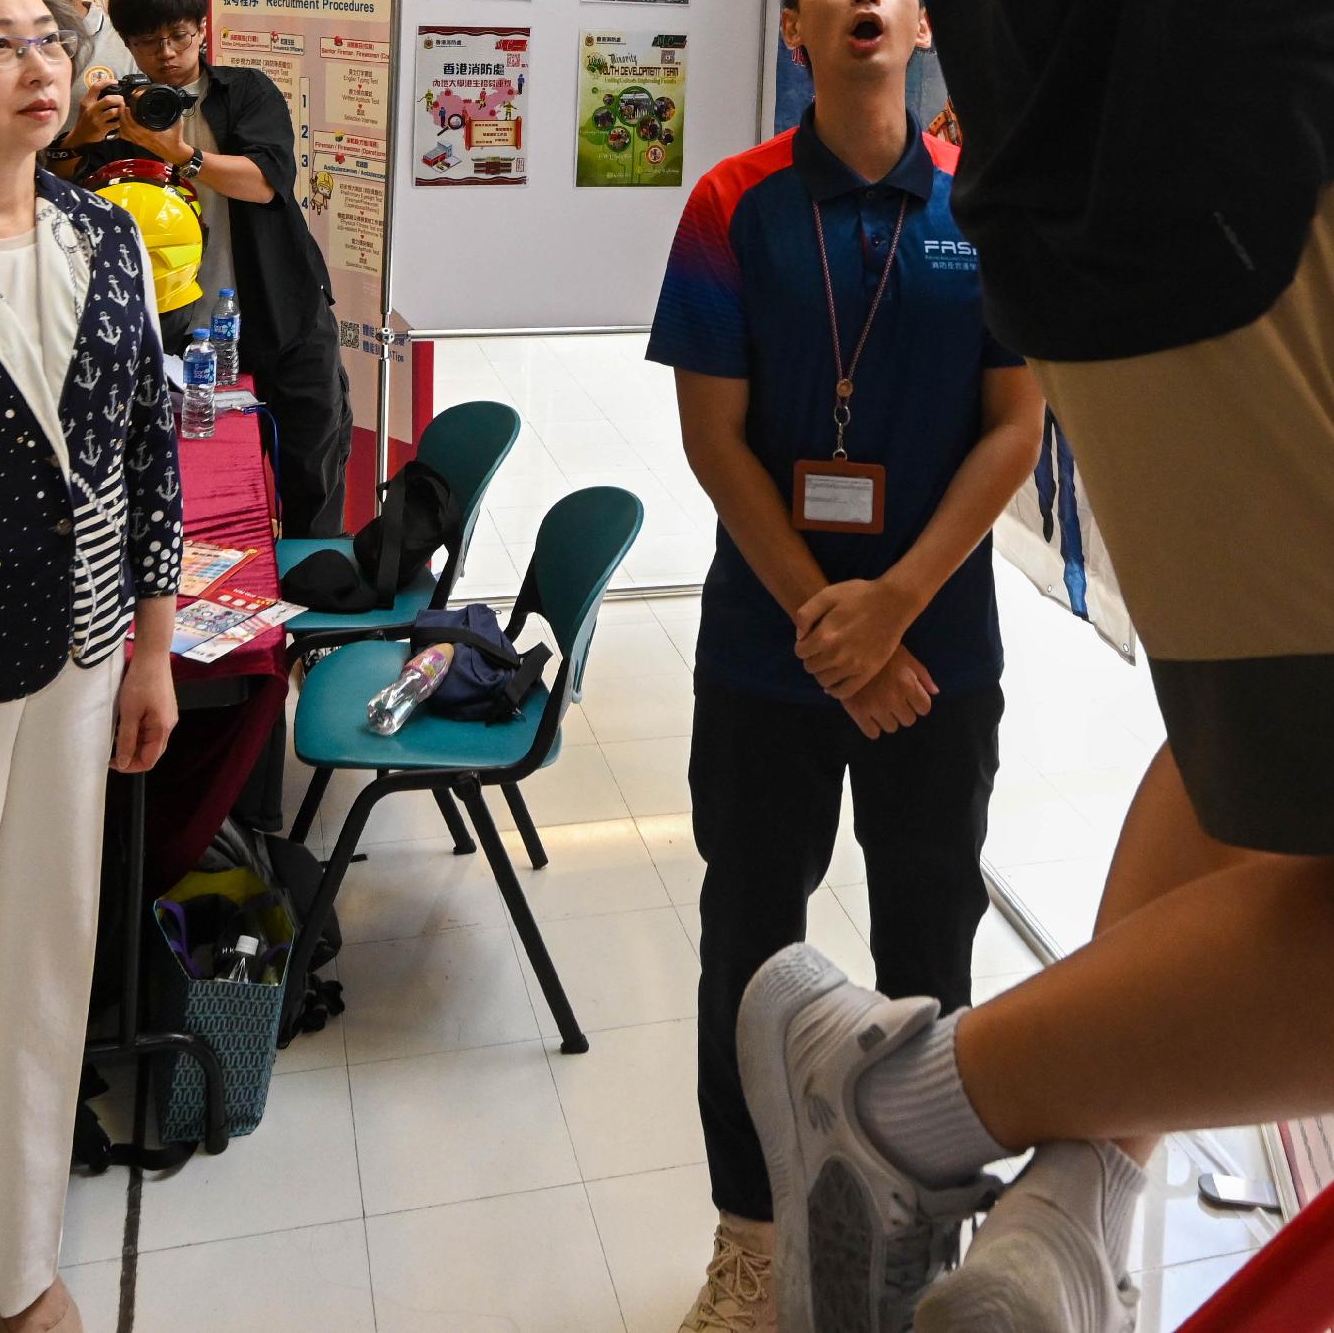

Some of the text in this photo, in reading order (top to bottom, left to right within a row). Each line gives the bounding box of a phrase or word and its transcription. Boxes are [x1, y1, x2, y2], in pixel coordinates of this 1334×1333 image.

[323, 0, 374, 13] Procedures
[443, 62, 505, 75] 香港消防處
[303, 95, 307, 108] 1
[302, 125, 308, 138] 2
[302, 155, 308, 167] 3
[302, 197, 308, 209] 4
